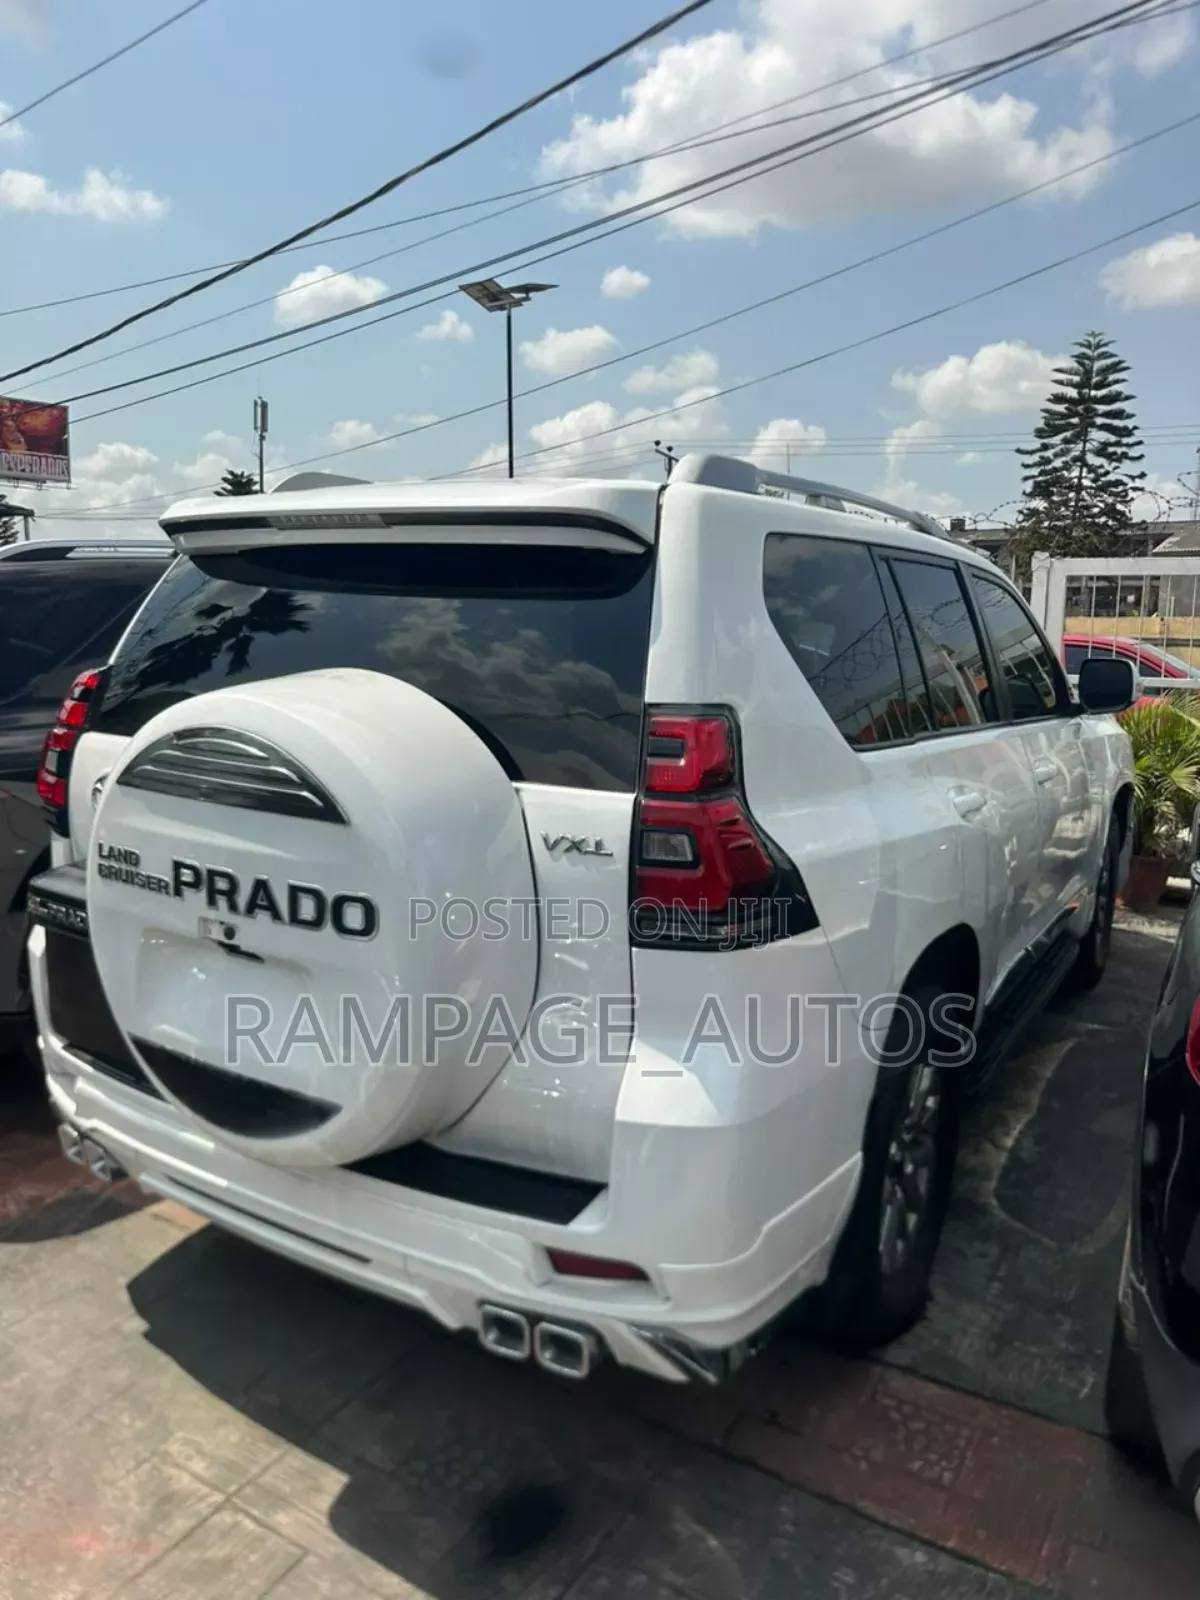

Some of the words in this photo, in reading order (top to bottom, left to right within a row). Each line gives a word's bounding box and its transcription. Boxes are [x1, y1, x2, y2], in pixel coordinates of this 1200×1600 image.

[0, 452, 69, 477] ESPERADOS
[98, 841, 141, 868] LAND
[540, 830, 613, 857] VXL
[98, 862, 171, 897] CRUISER
[172, 857, 379, 941] PRADO
